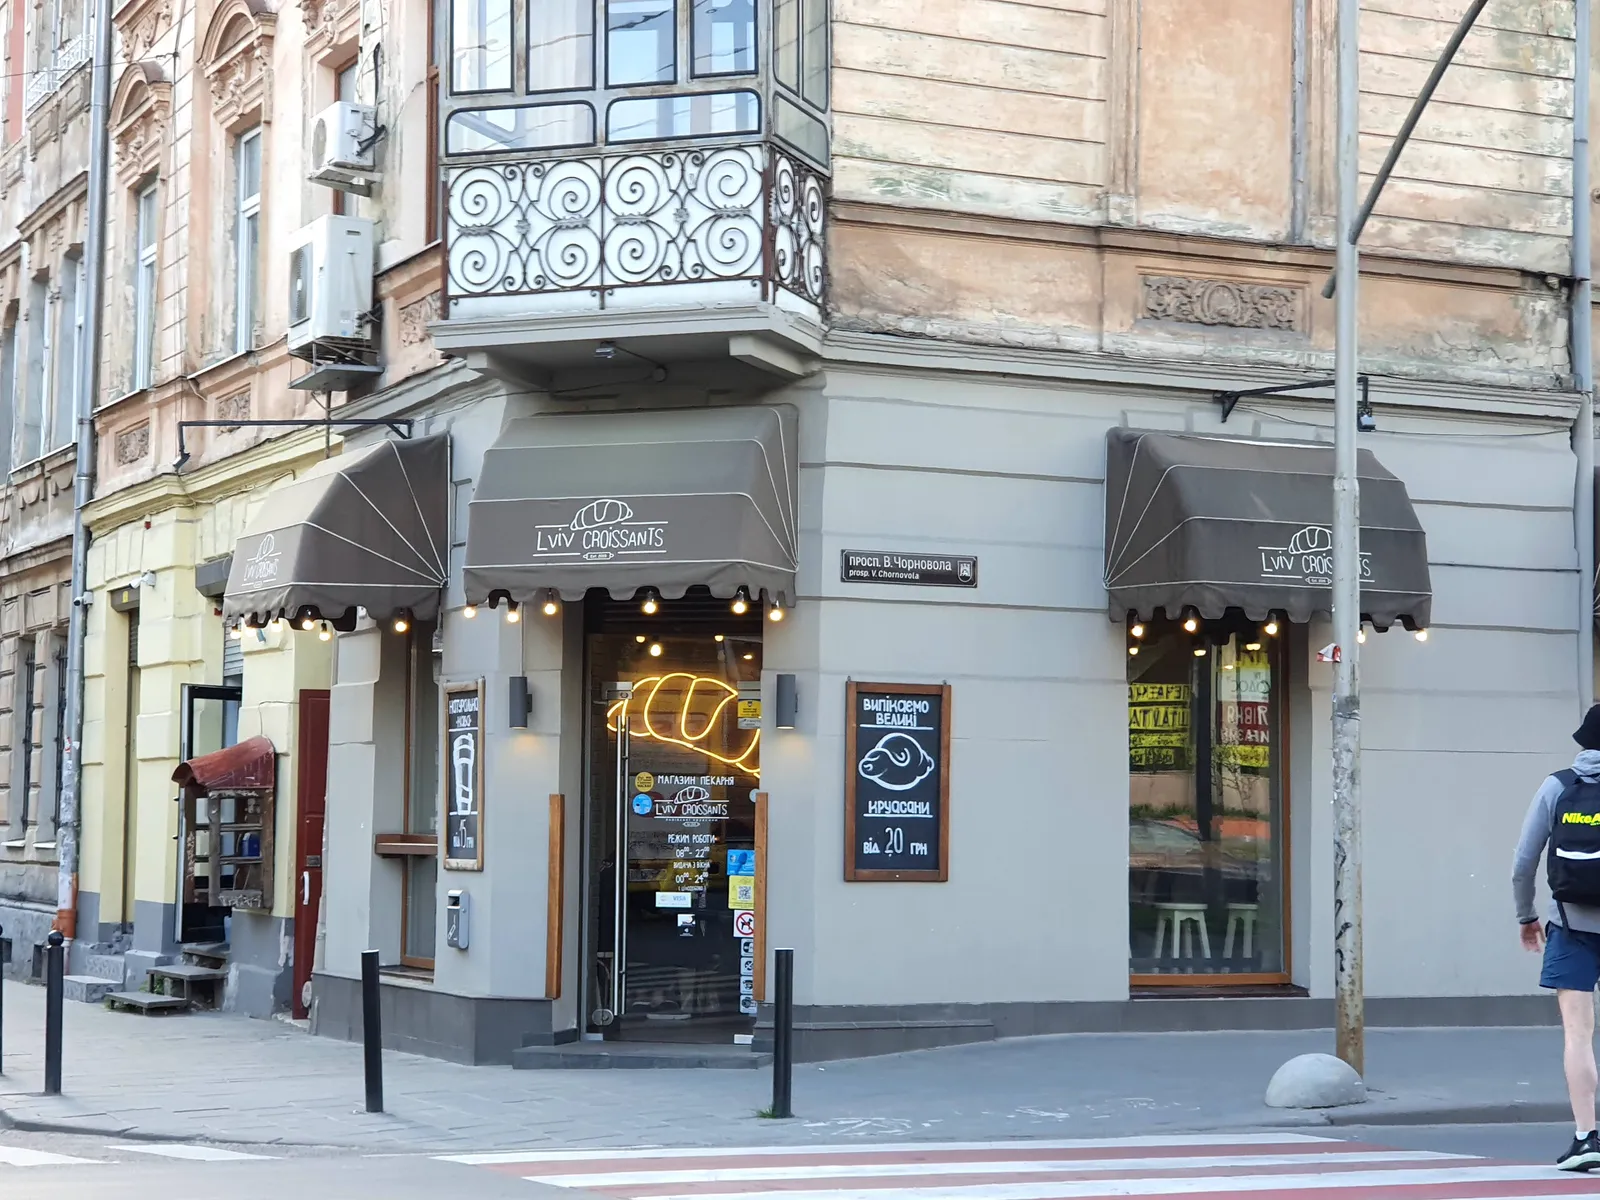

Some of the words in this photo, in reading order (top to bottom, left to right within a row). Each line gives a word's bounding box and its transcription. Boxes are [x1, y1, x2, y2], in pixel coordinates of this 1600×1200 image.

[894, 556, 952, 571] Чорновола
[849, 569, 870, 577] prosp.
[871, 570, 878, 578] V.
[878, 570, 920, 580] Chornovola
[658, 775, 696, 785] МАГАЗИН
[700, 775, 735, 786] ПЕКАРНЯ
[668, 834, 690, 843] РЕЖИМ
[692, 834, 716, 843] РОБОТИ
[884, 827, 903, 857] 20
